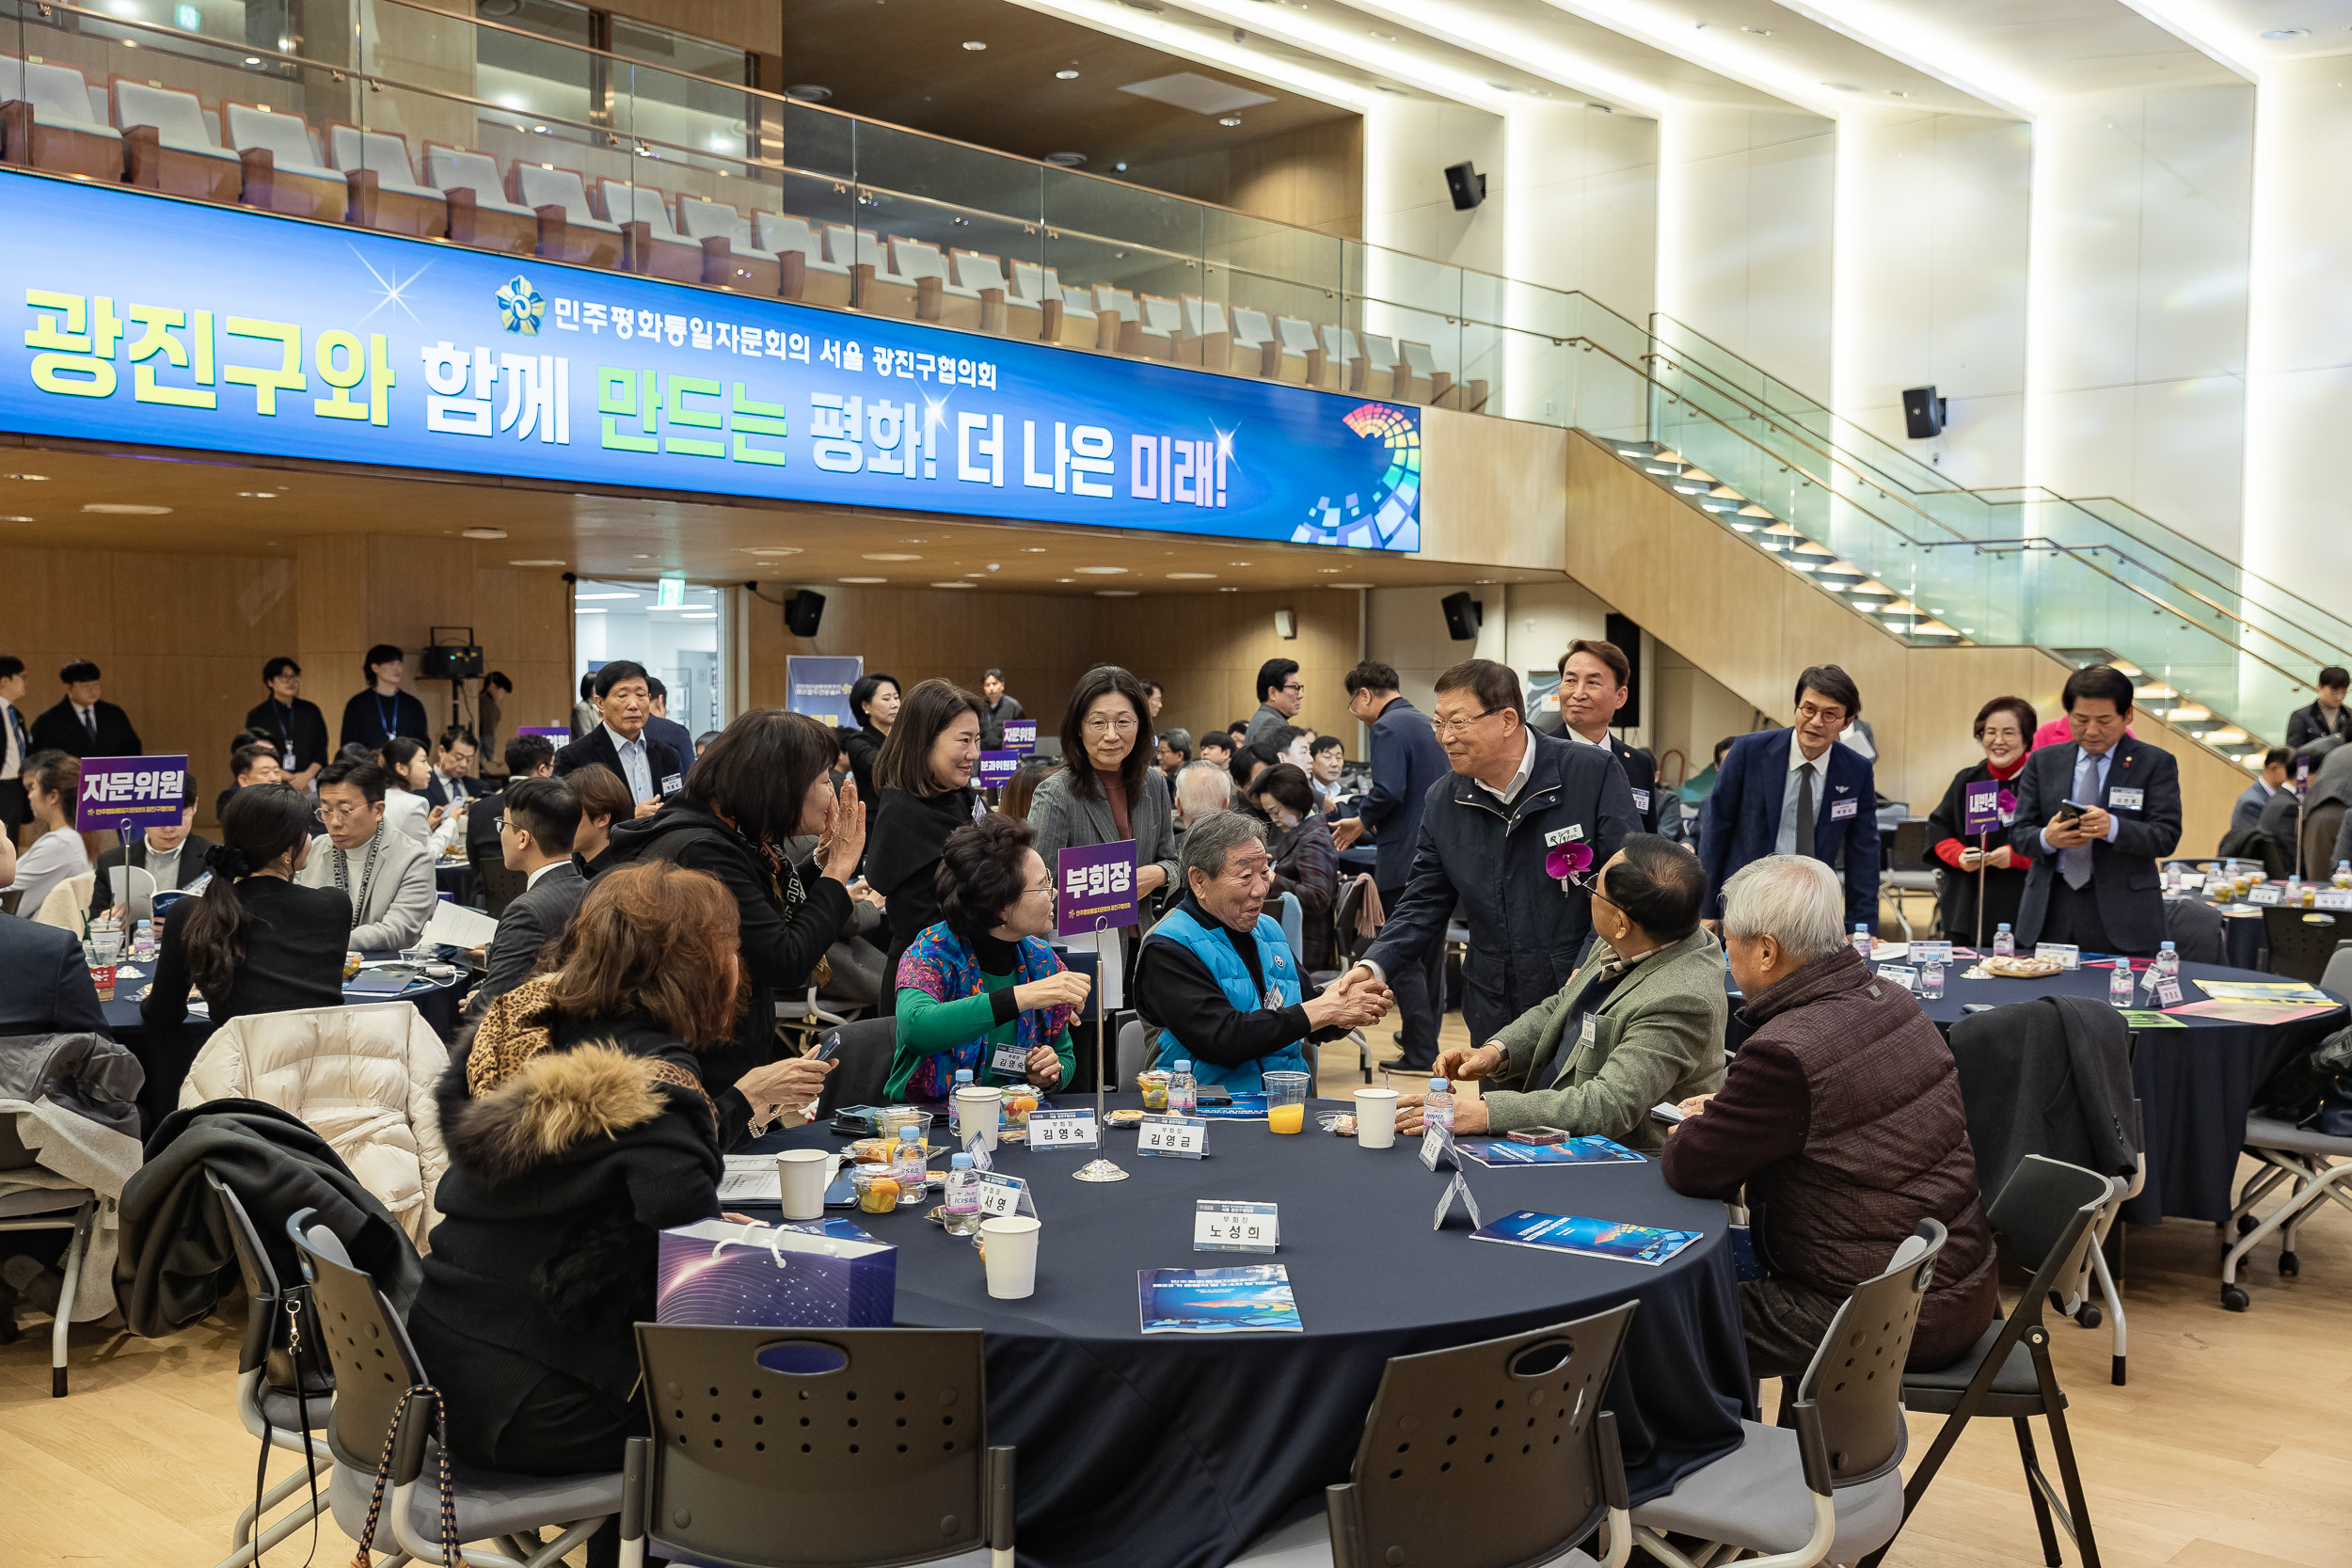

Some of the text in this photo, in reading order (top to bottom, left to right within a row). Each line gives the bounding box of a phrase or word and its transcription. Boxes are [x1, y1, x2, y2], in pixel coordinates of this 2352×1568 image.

[554, 297, 997, 390] 민주평화통일자문회의 서울 광진구협의회
[24, 288, 1228, 509] 광진구와 함께 만드는 평화! 더 나은 미래!
[1003, 726, 1037, 742] 자문위원
[82, 770, 184, 801] 자문위원
[1969, 792, 1997, 813] 내빈석
[1066, 861, 1132, 899] 부회장
[999, 1058, 1025, 1069] 김영숙
[1042, 1128, 1084, 1140] 김영숙
[1151, 1134, 1191, 1148] 김영금
[984, 1196, 1007, 1212] 서영
[1210, 1225, 1260, 1240] 노성희
